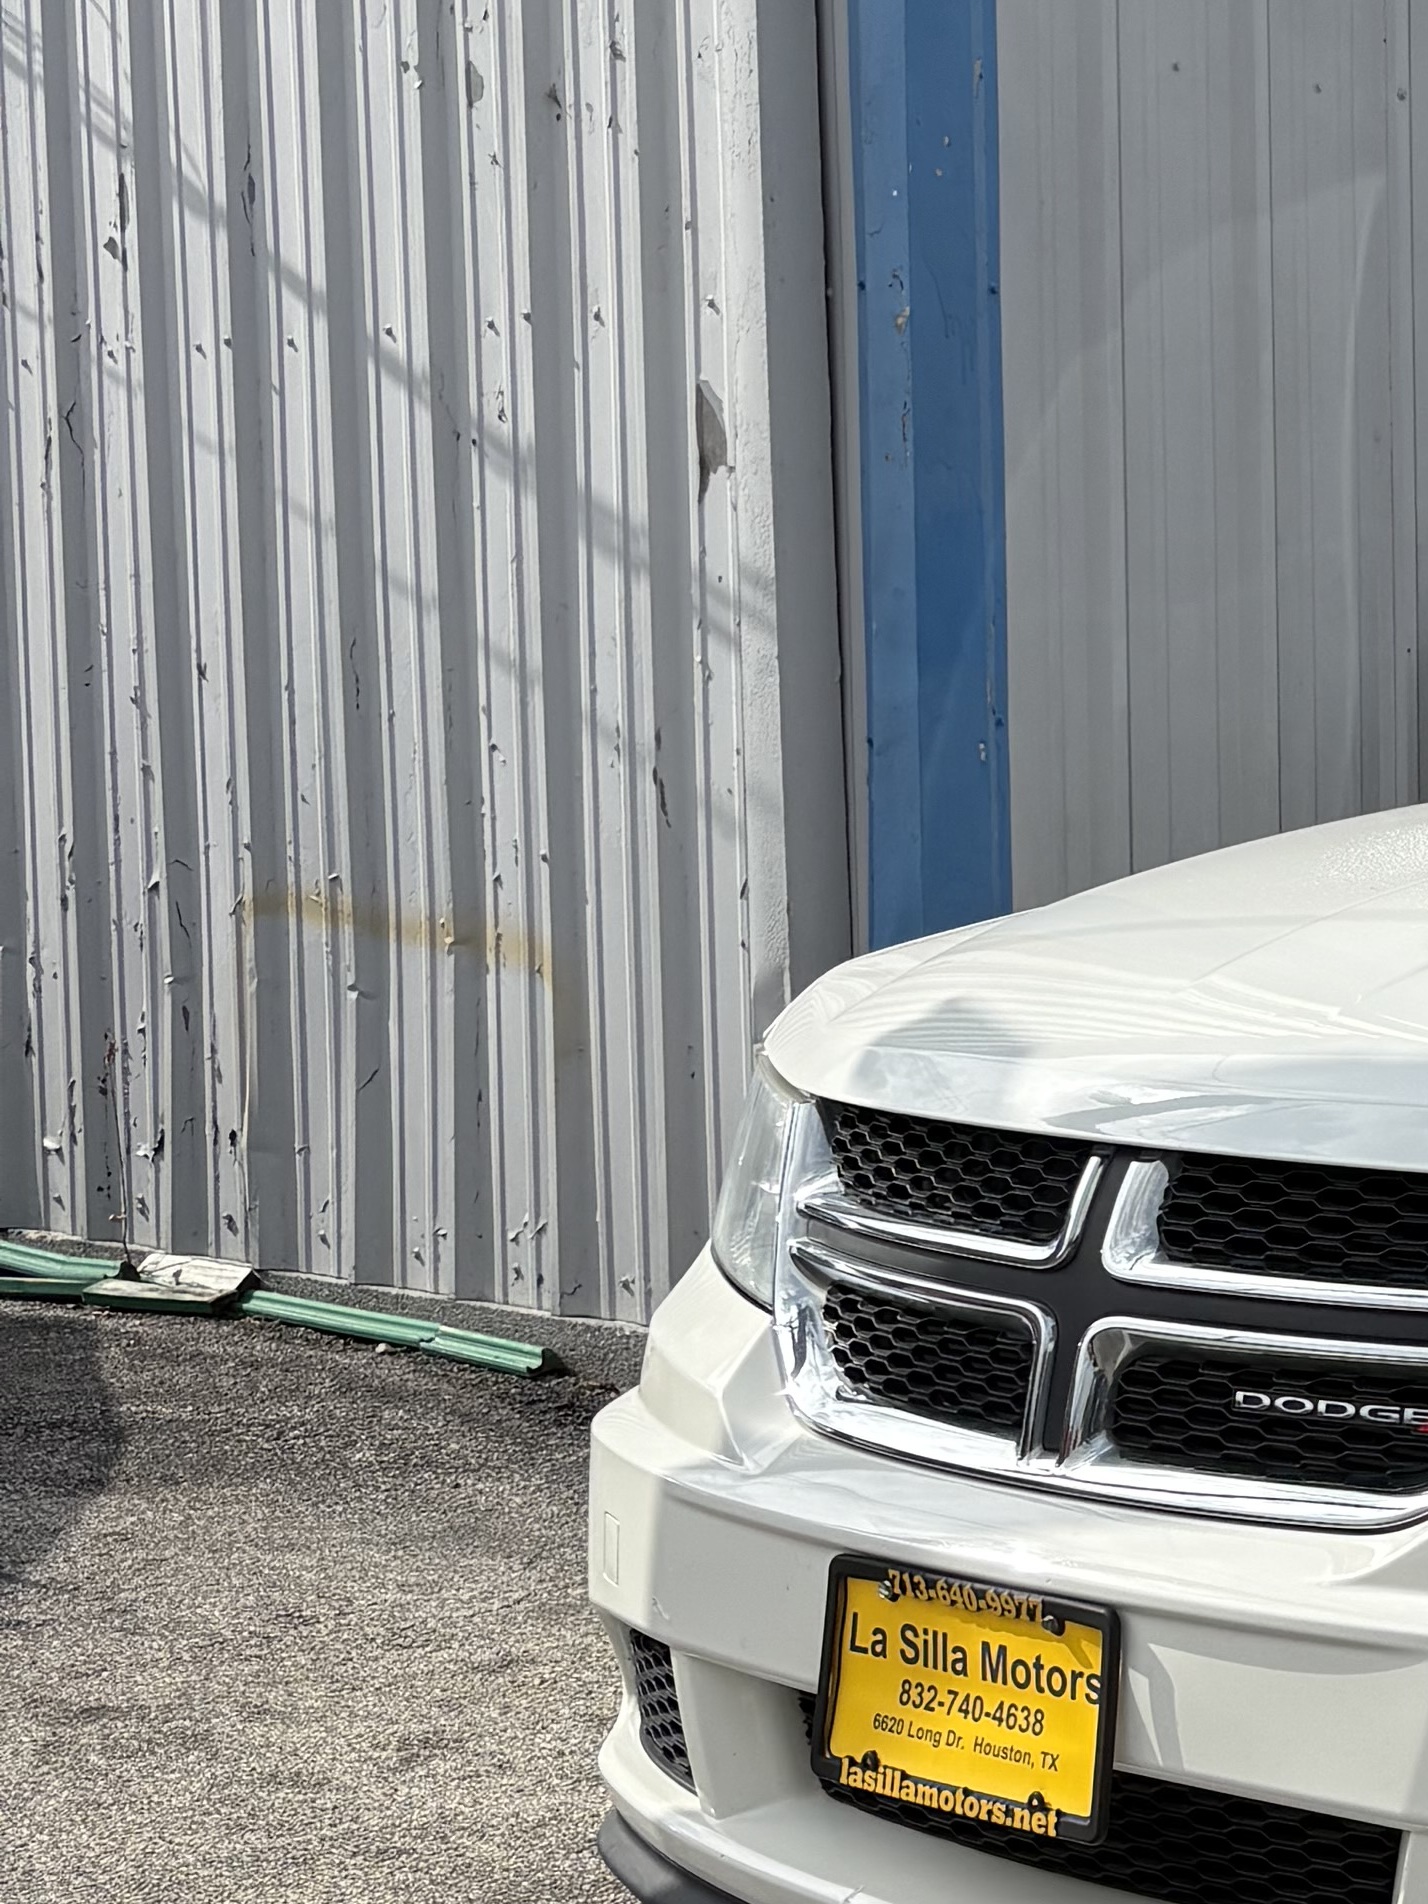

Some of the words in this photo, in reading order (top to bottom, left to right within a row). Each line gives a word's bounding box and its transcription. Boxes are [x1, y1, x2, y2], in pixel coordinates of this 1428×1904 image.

[888, 1569, 1043, 1622] 713-640-9977
[849, 1611, 887, 1659] La
[900, 1623, 969, 1677] Silla
[981, 1640, 1102, 1705] Motors
[899, 1679, 1045, 1736] 832-740-4638
[873, 1712, 905, 1735] 6620
[907, 1721, 942, 1748] Long
[945, 1729, 965, 1750] Dr.
[973, 1736, 1035, 1769] Houston,
[1040, 1751, 1060, 1772] TX
[839, 1758, 1058, 1837] lasillamotors.net
